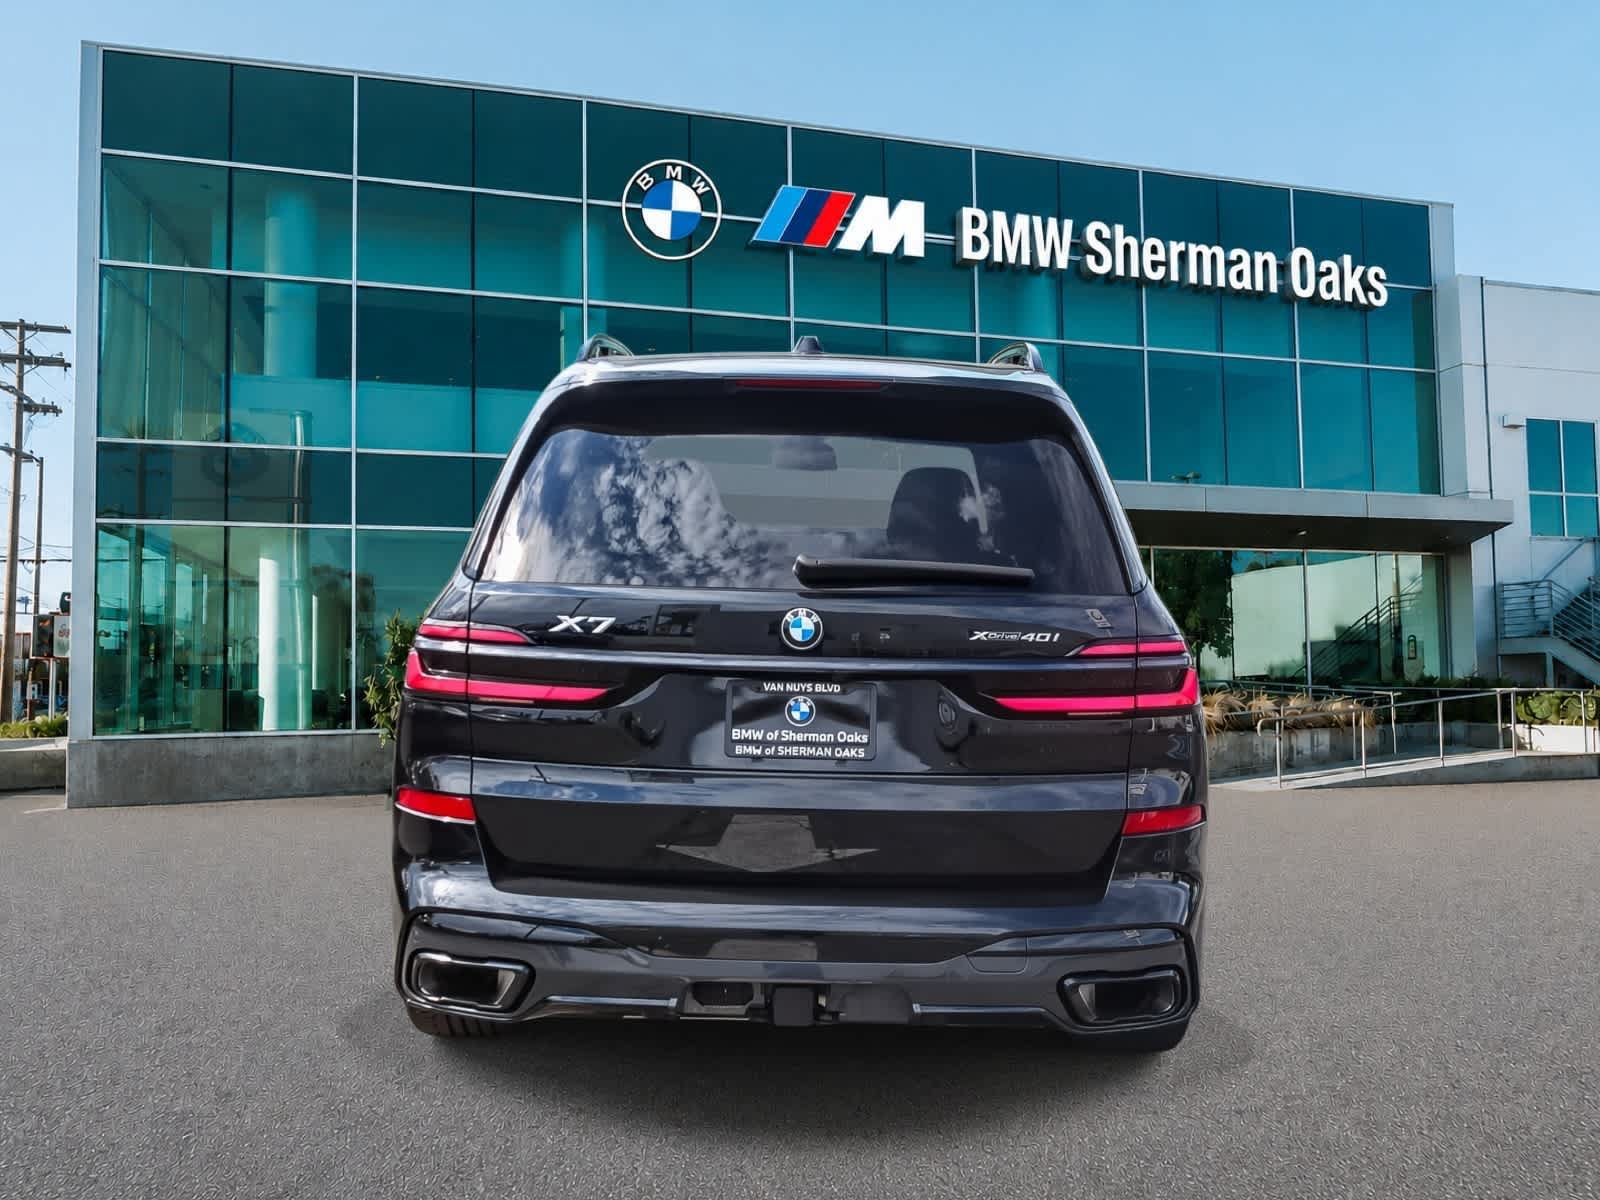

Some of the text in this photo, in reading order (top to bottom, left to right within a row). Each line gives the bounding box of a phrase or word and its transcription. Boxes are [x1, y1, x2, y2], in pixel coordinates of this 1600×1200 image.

[636, 165, 712, 196] BMW
[960, 206, 1389, 308] BMW Sherman Oaks
[548, 614, 617, 634] X7
[763, 682, 841, 693] VAN NUYS BLVD
[731, 728, 868, 744] BMW of Sherman Oaks
[735, 745, 865, 758] BMW of SHERMAN OAKS
